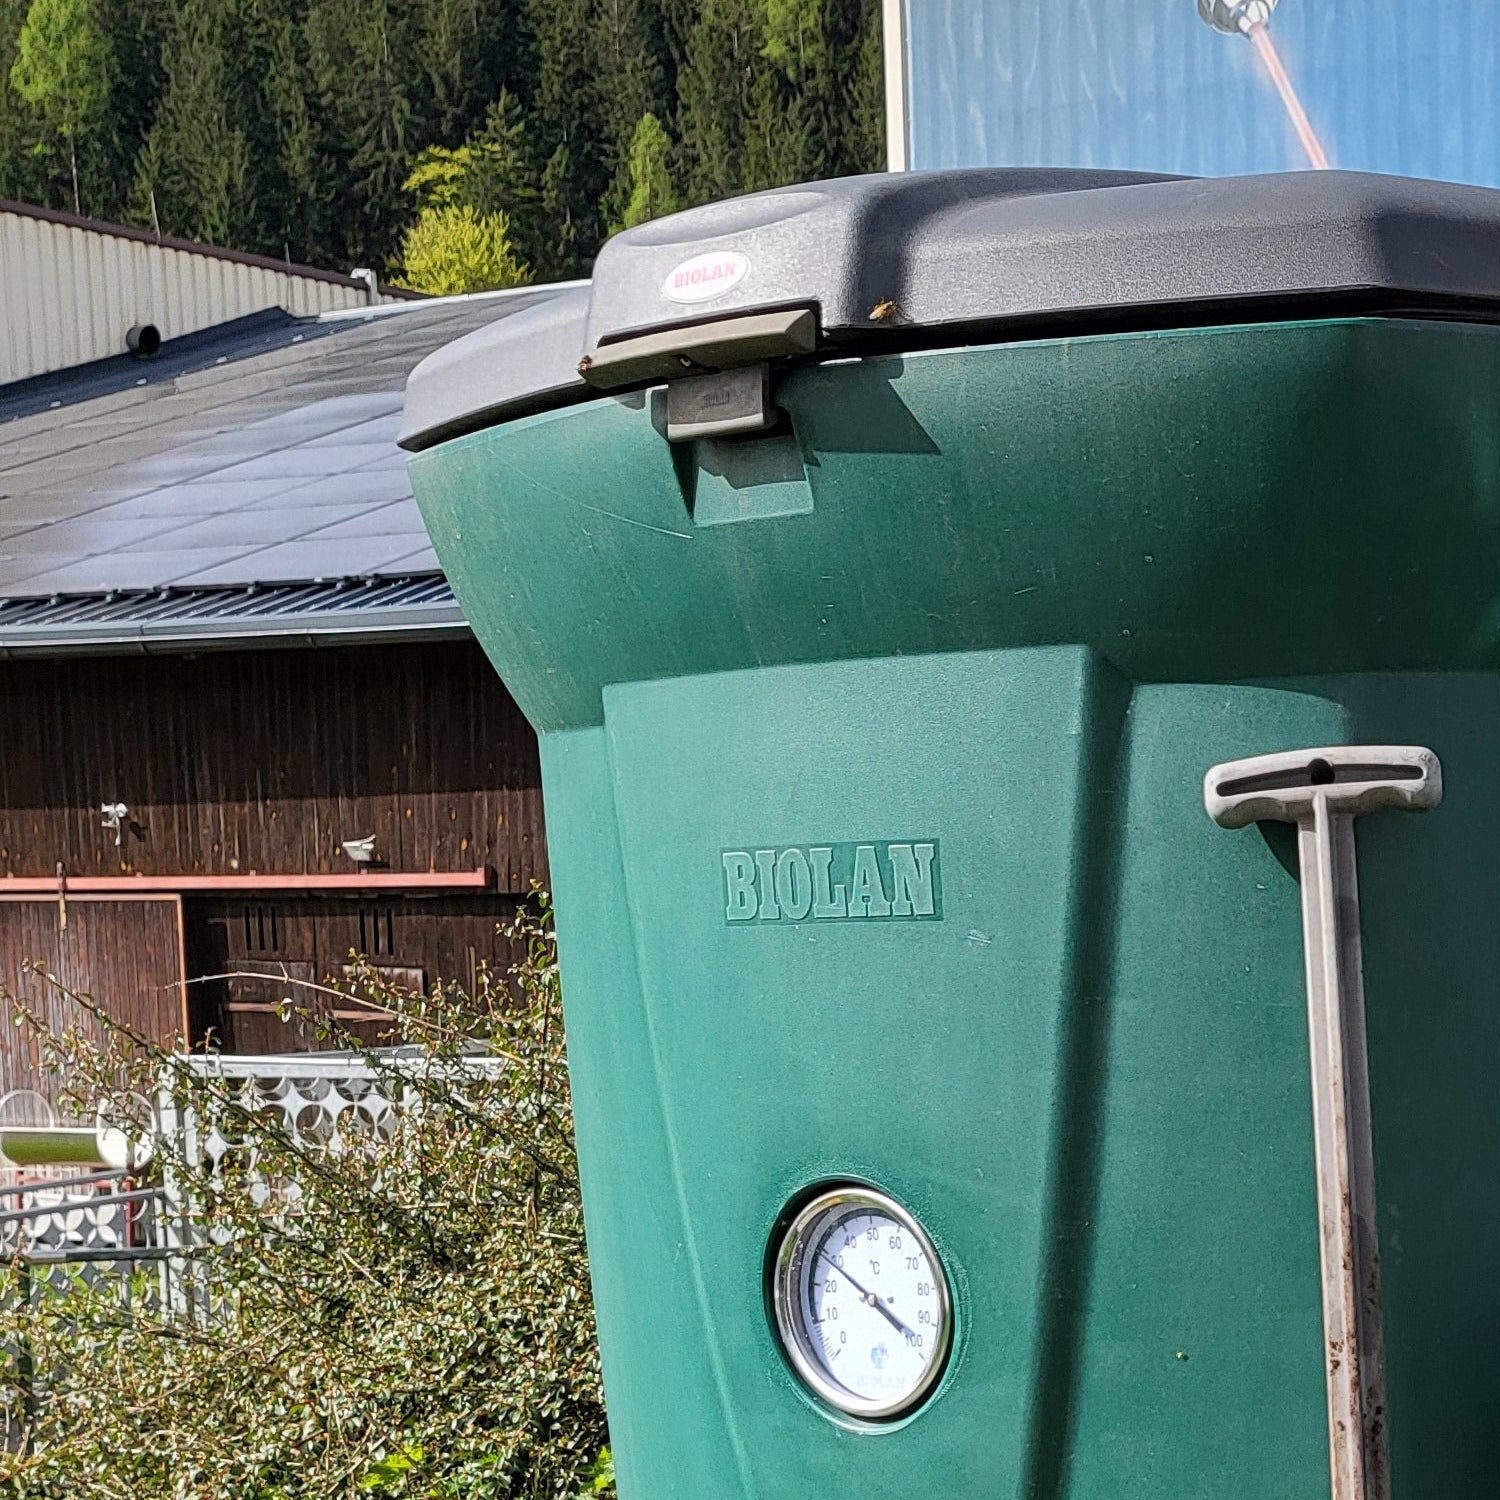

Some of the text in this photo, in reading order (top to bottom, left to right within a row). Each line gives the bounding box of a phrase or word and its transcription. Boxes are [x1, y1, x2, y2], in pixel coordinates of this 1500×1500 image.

[672, 262, 737, 288] BIOLAN
[722, 844, 935, 922] BIOLAN
[866, 1227, 879, 1241] 50
[844, 1235, 857, 1249] 40
[889, 1236, 902, 1250] 60
[905, 1257, 919, 1271] 70
[824, 1279, 838, 1293] 20
[917, 1282, 930, 1296] 80
[827, 1306, 838, 1320] 10
[917, 1310, 930, 1324] 90
[840, 1331, 846, 1345] 0
[905, 1334, 923, 1347] 100
